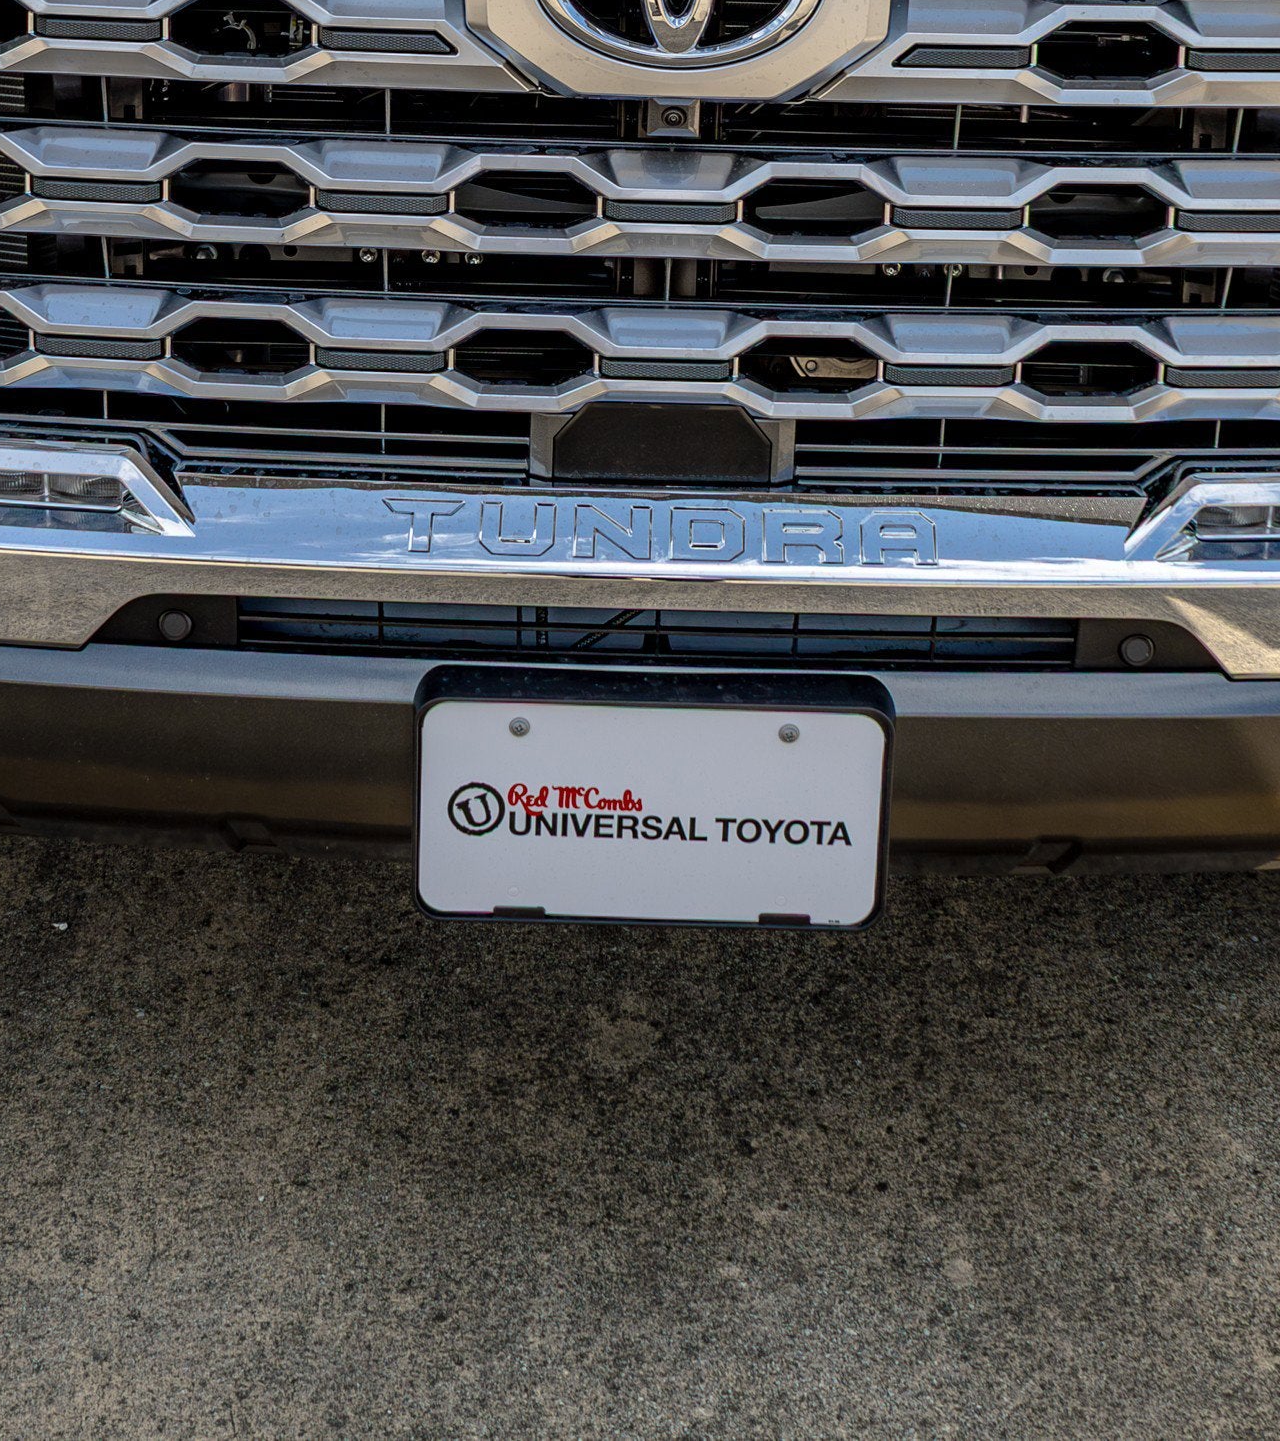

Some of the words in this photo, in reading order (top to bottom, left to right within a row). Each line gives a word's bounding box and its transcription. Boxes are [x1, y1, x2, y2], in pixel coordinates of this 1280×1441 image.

[381, 497, 939, 567] TUNDRA
[507, 783, 549, 817] Red
[552, 784, 643, 813] McCombs
[508, 811, 708, 842] UNIVERSAL
[715, 816, 853, 847] TOYOTA
